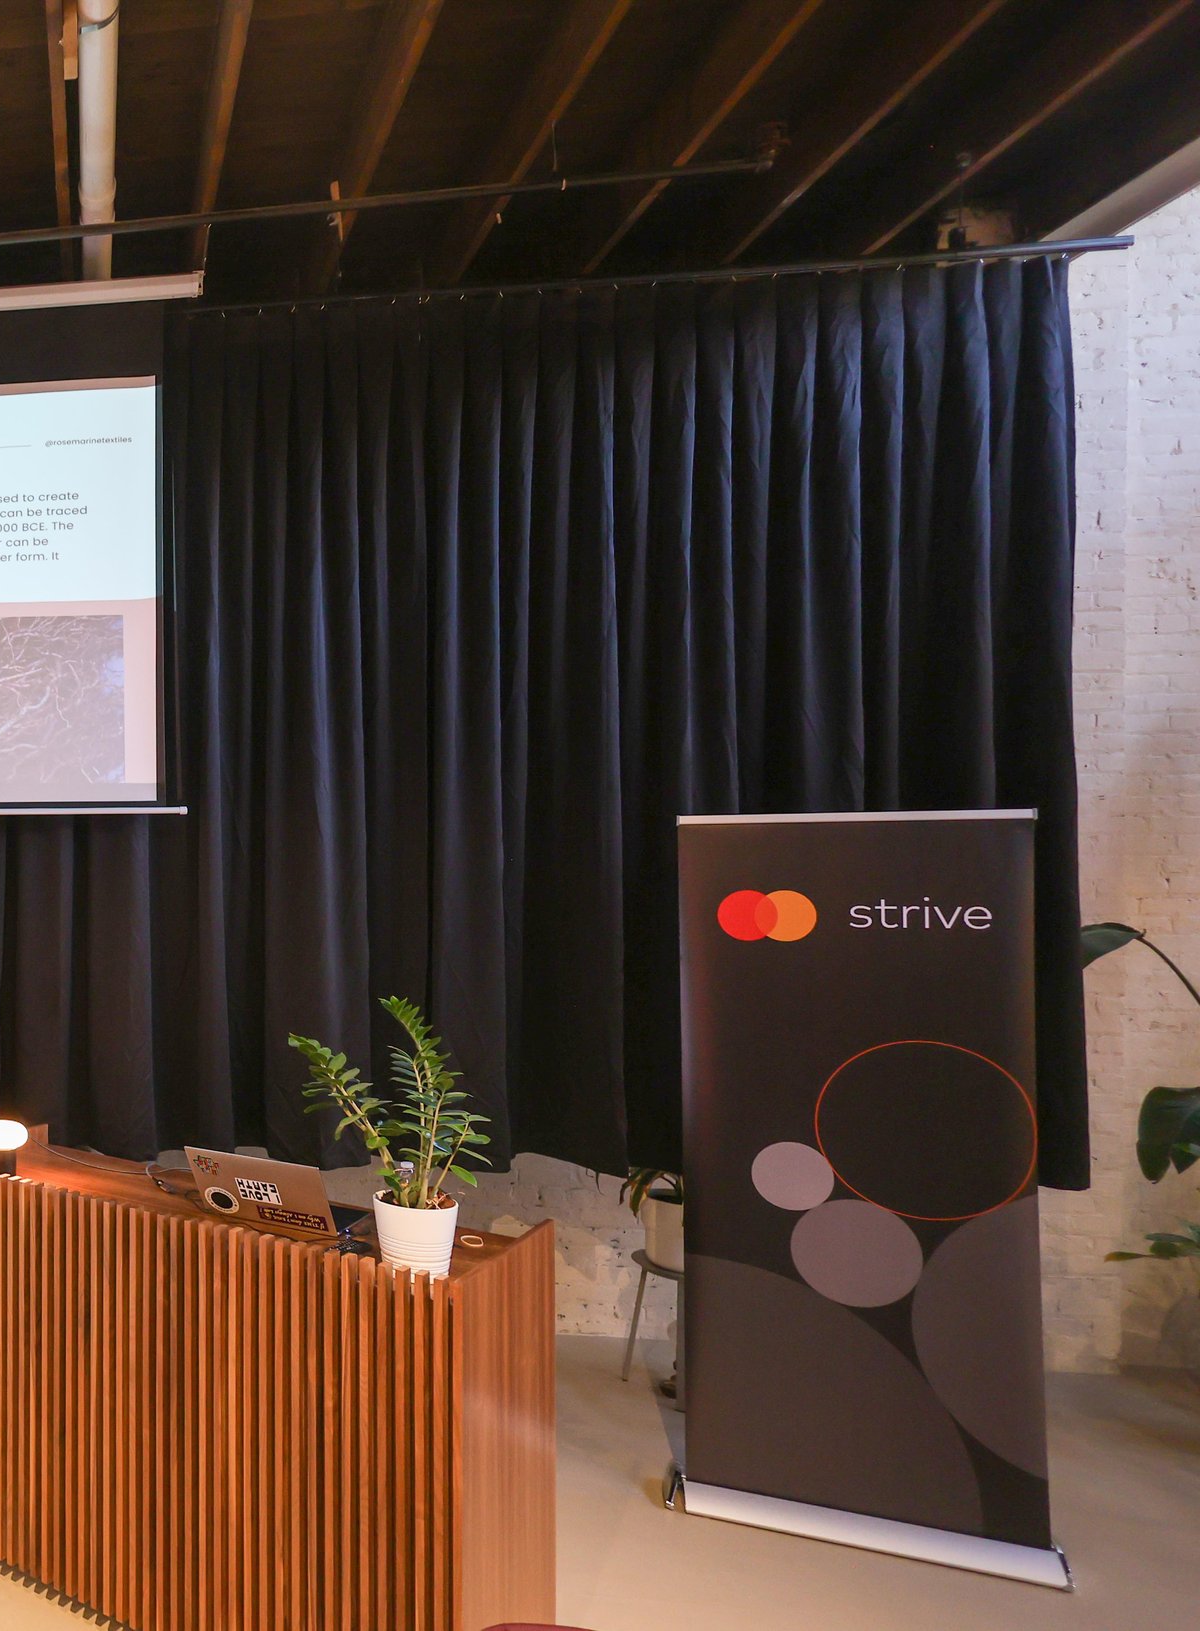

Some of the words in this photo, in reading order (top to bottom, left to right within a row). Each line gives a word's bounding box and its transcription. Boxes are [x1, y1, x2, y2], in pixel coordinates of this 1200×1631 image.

[45, 436, 133, 447] @rosemarinetextiles
[22, 494, 35, 502] to
[38, 492, 79, 502] create
[0, 510, 23, 518] can
[26, 507, 43, 517] be
[46, 505, 88, 516] traced
[22, 522, 48, 532] BCE.
[51, 521, 74, 531] The
[5, 539, 29, 547] can
[33, 537, 49, 546] be
[16, 552, 48, 562] form.
[52, 552, 59, 560] It
[849, 896, 993, 930] strive
[236, 1178, 277, 1193] EARTH
[239, 1188, 271, 1203] LOVE
